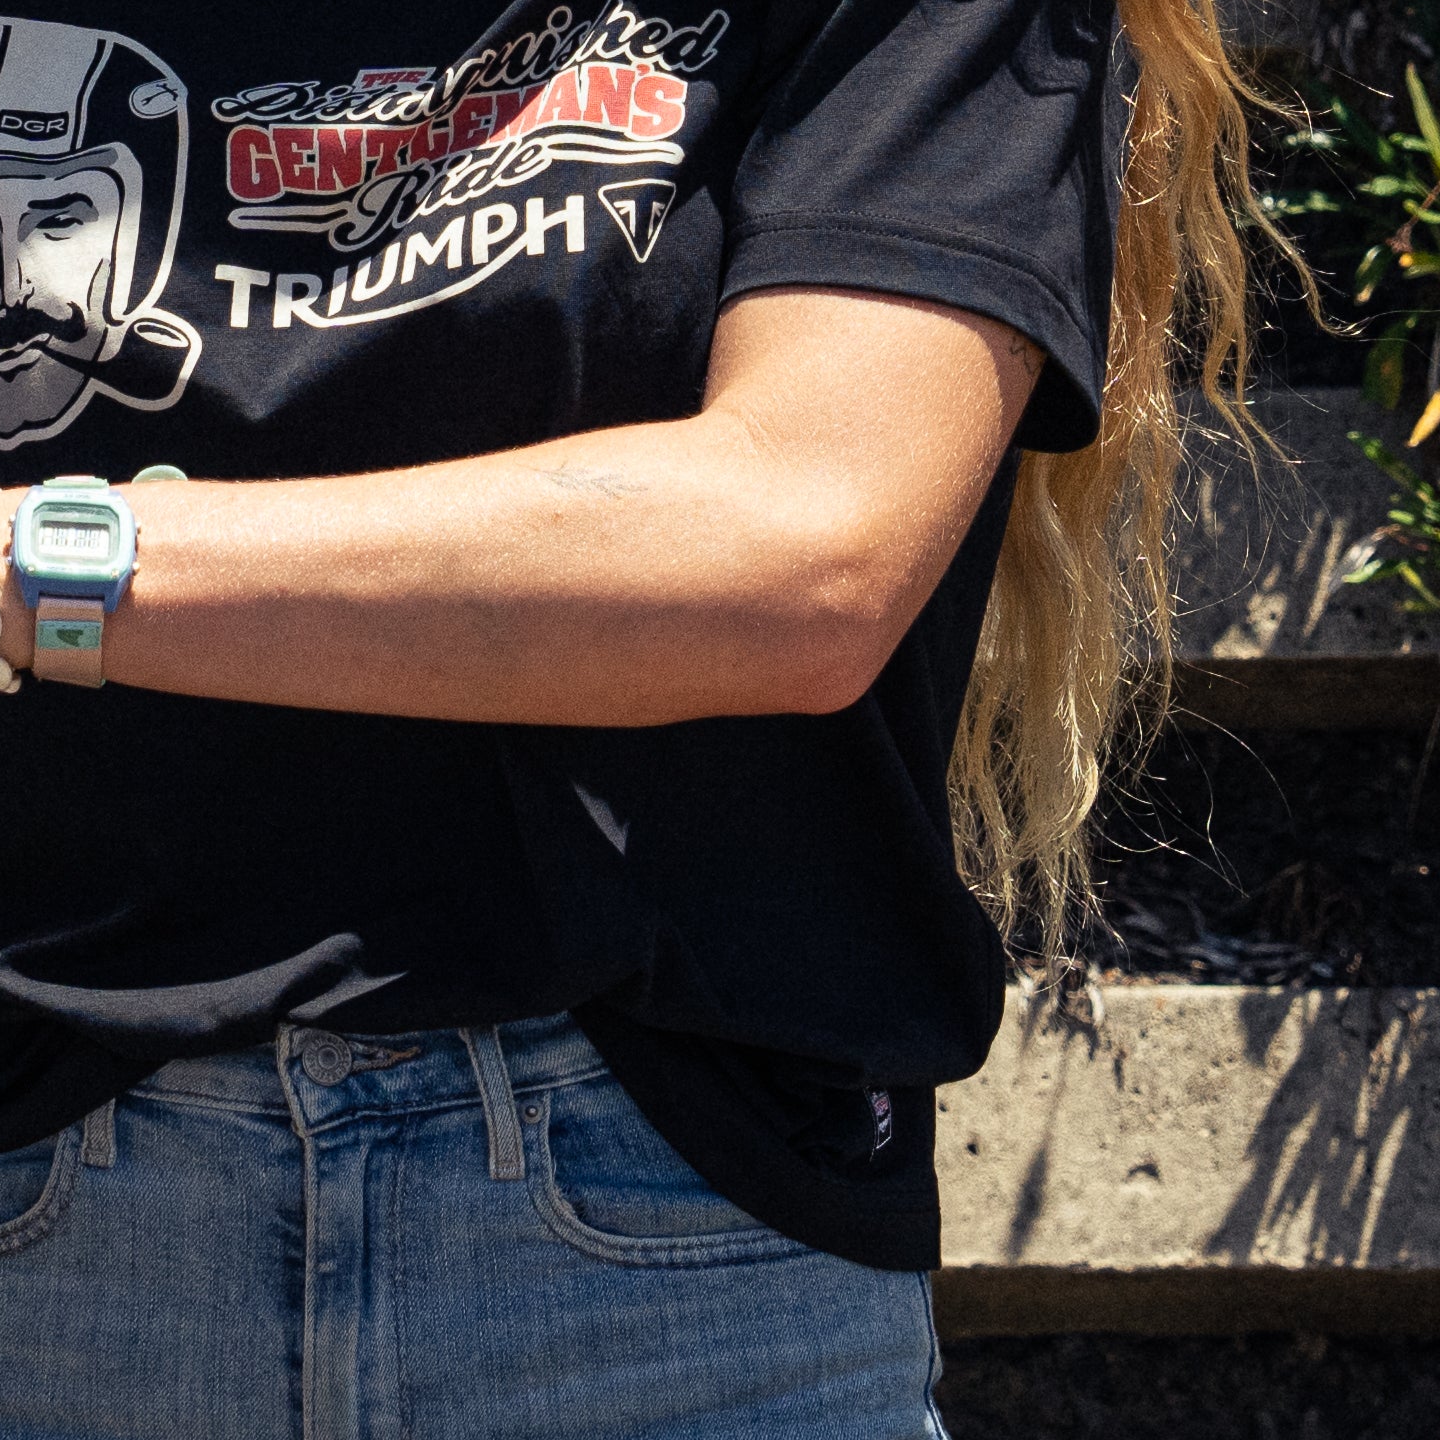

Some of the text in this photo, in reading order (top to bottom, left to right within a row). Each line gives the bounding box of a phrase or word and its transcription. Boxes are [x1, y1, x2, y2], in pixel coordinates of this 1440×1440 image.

[361, 70, 428, 90] THE
[0, 114, 66, 134] DGR
[328, 133, 553, 252] Ride
[214, 194, 586, 329] TRIUMPH
